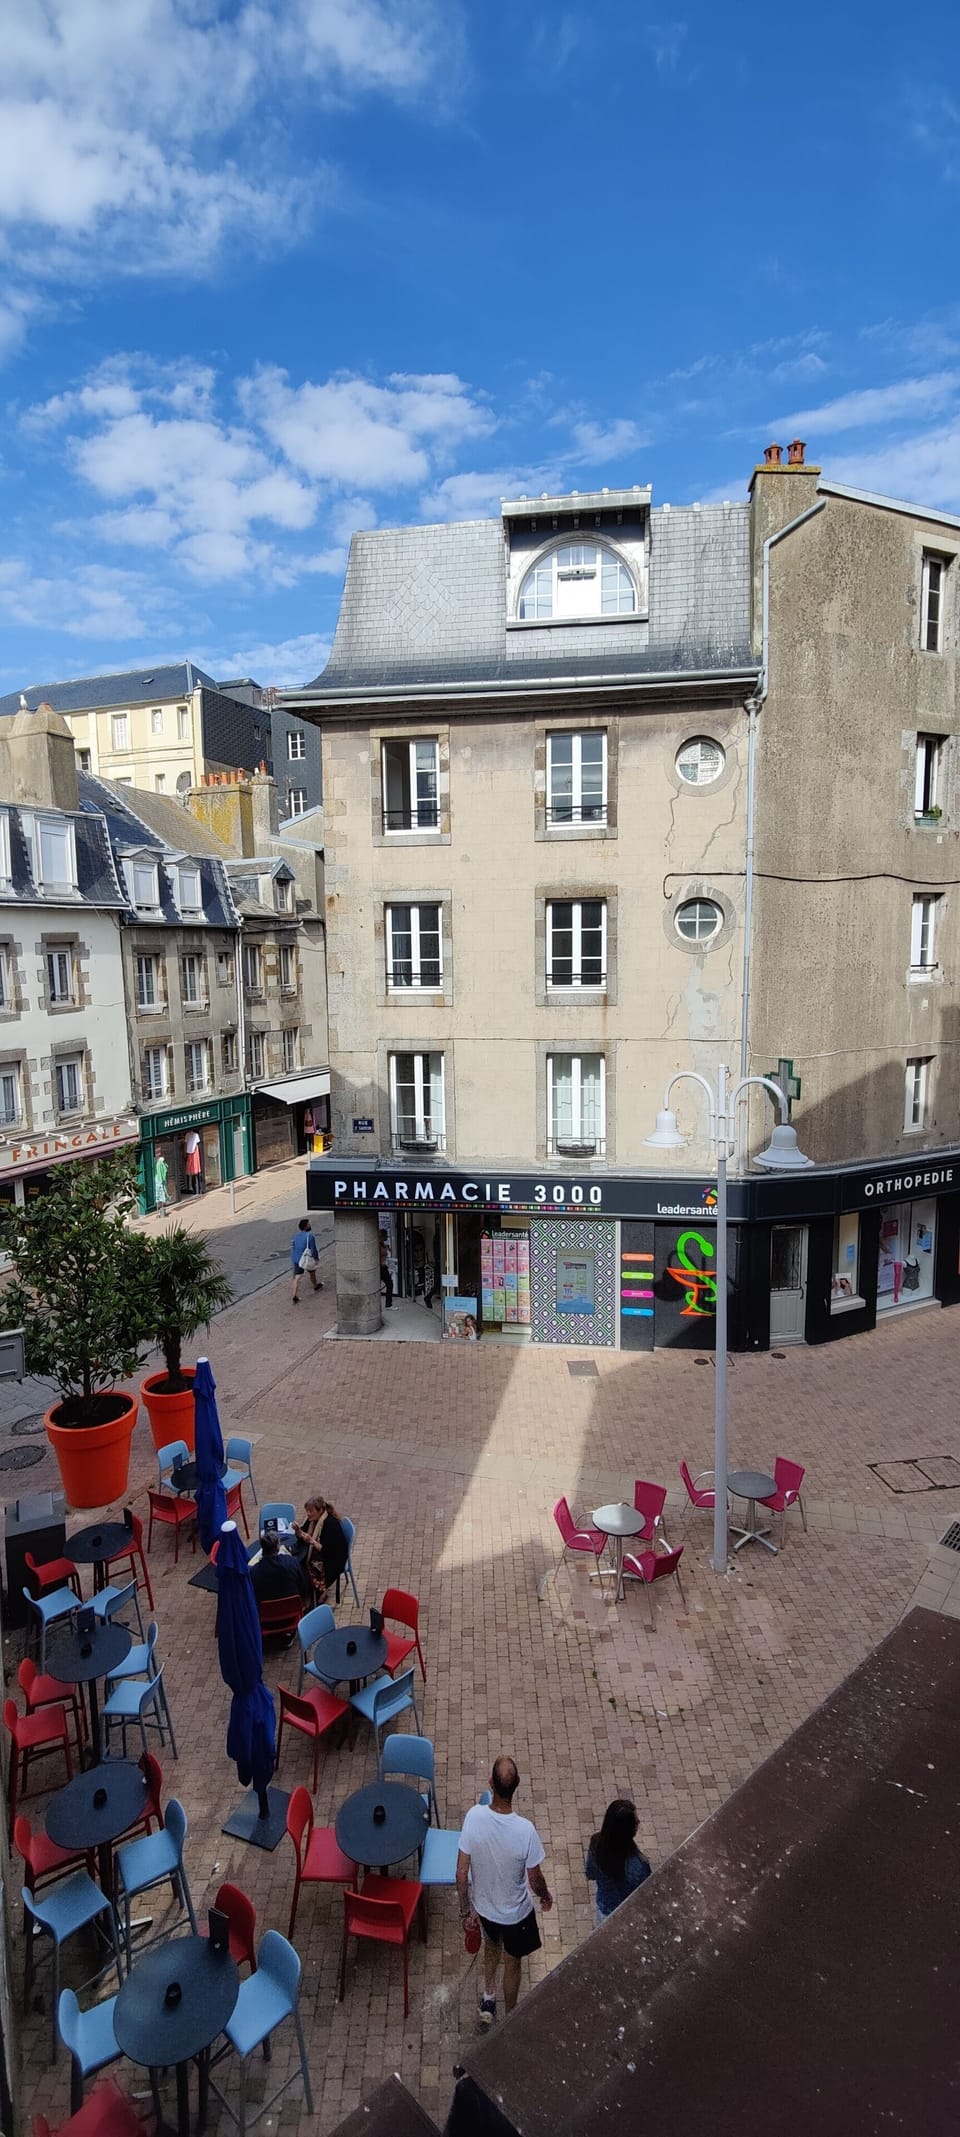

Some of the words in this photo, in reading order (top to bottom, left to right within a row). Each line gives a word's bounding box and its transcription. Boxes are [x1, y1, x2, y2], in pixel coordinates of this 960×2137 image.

[12, 1125, 121, 1162] FRINGALE
[334, 1181, 511, 1202] PHARMACIE
[534, 1185, 602, 1204] 3000
[865, 1170, 953, 1197] ORTHOPEDIE
[657, 1203, 718, 1215] Leadersanté
